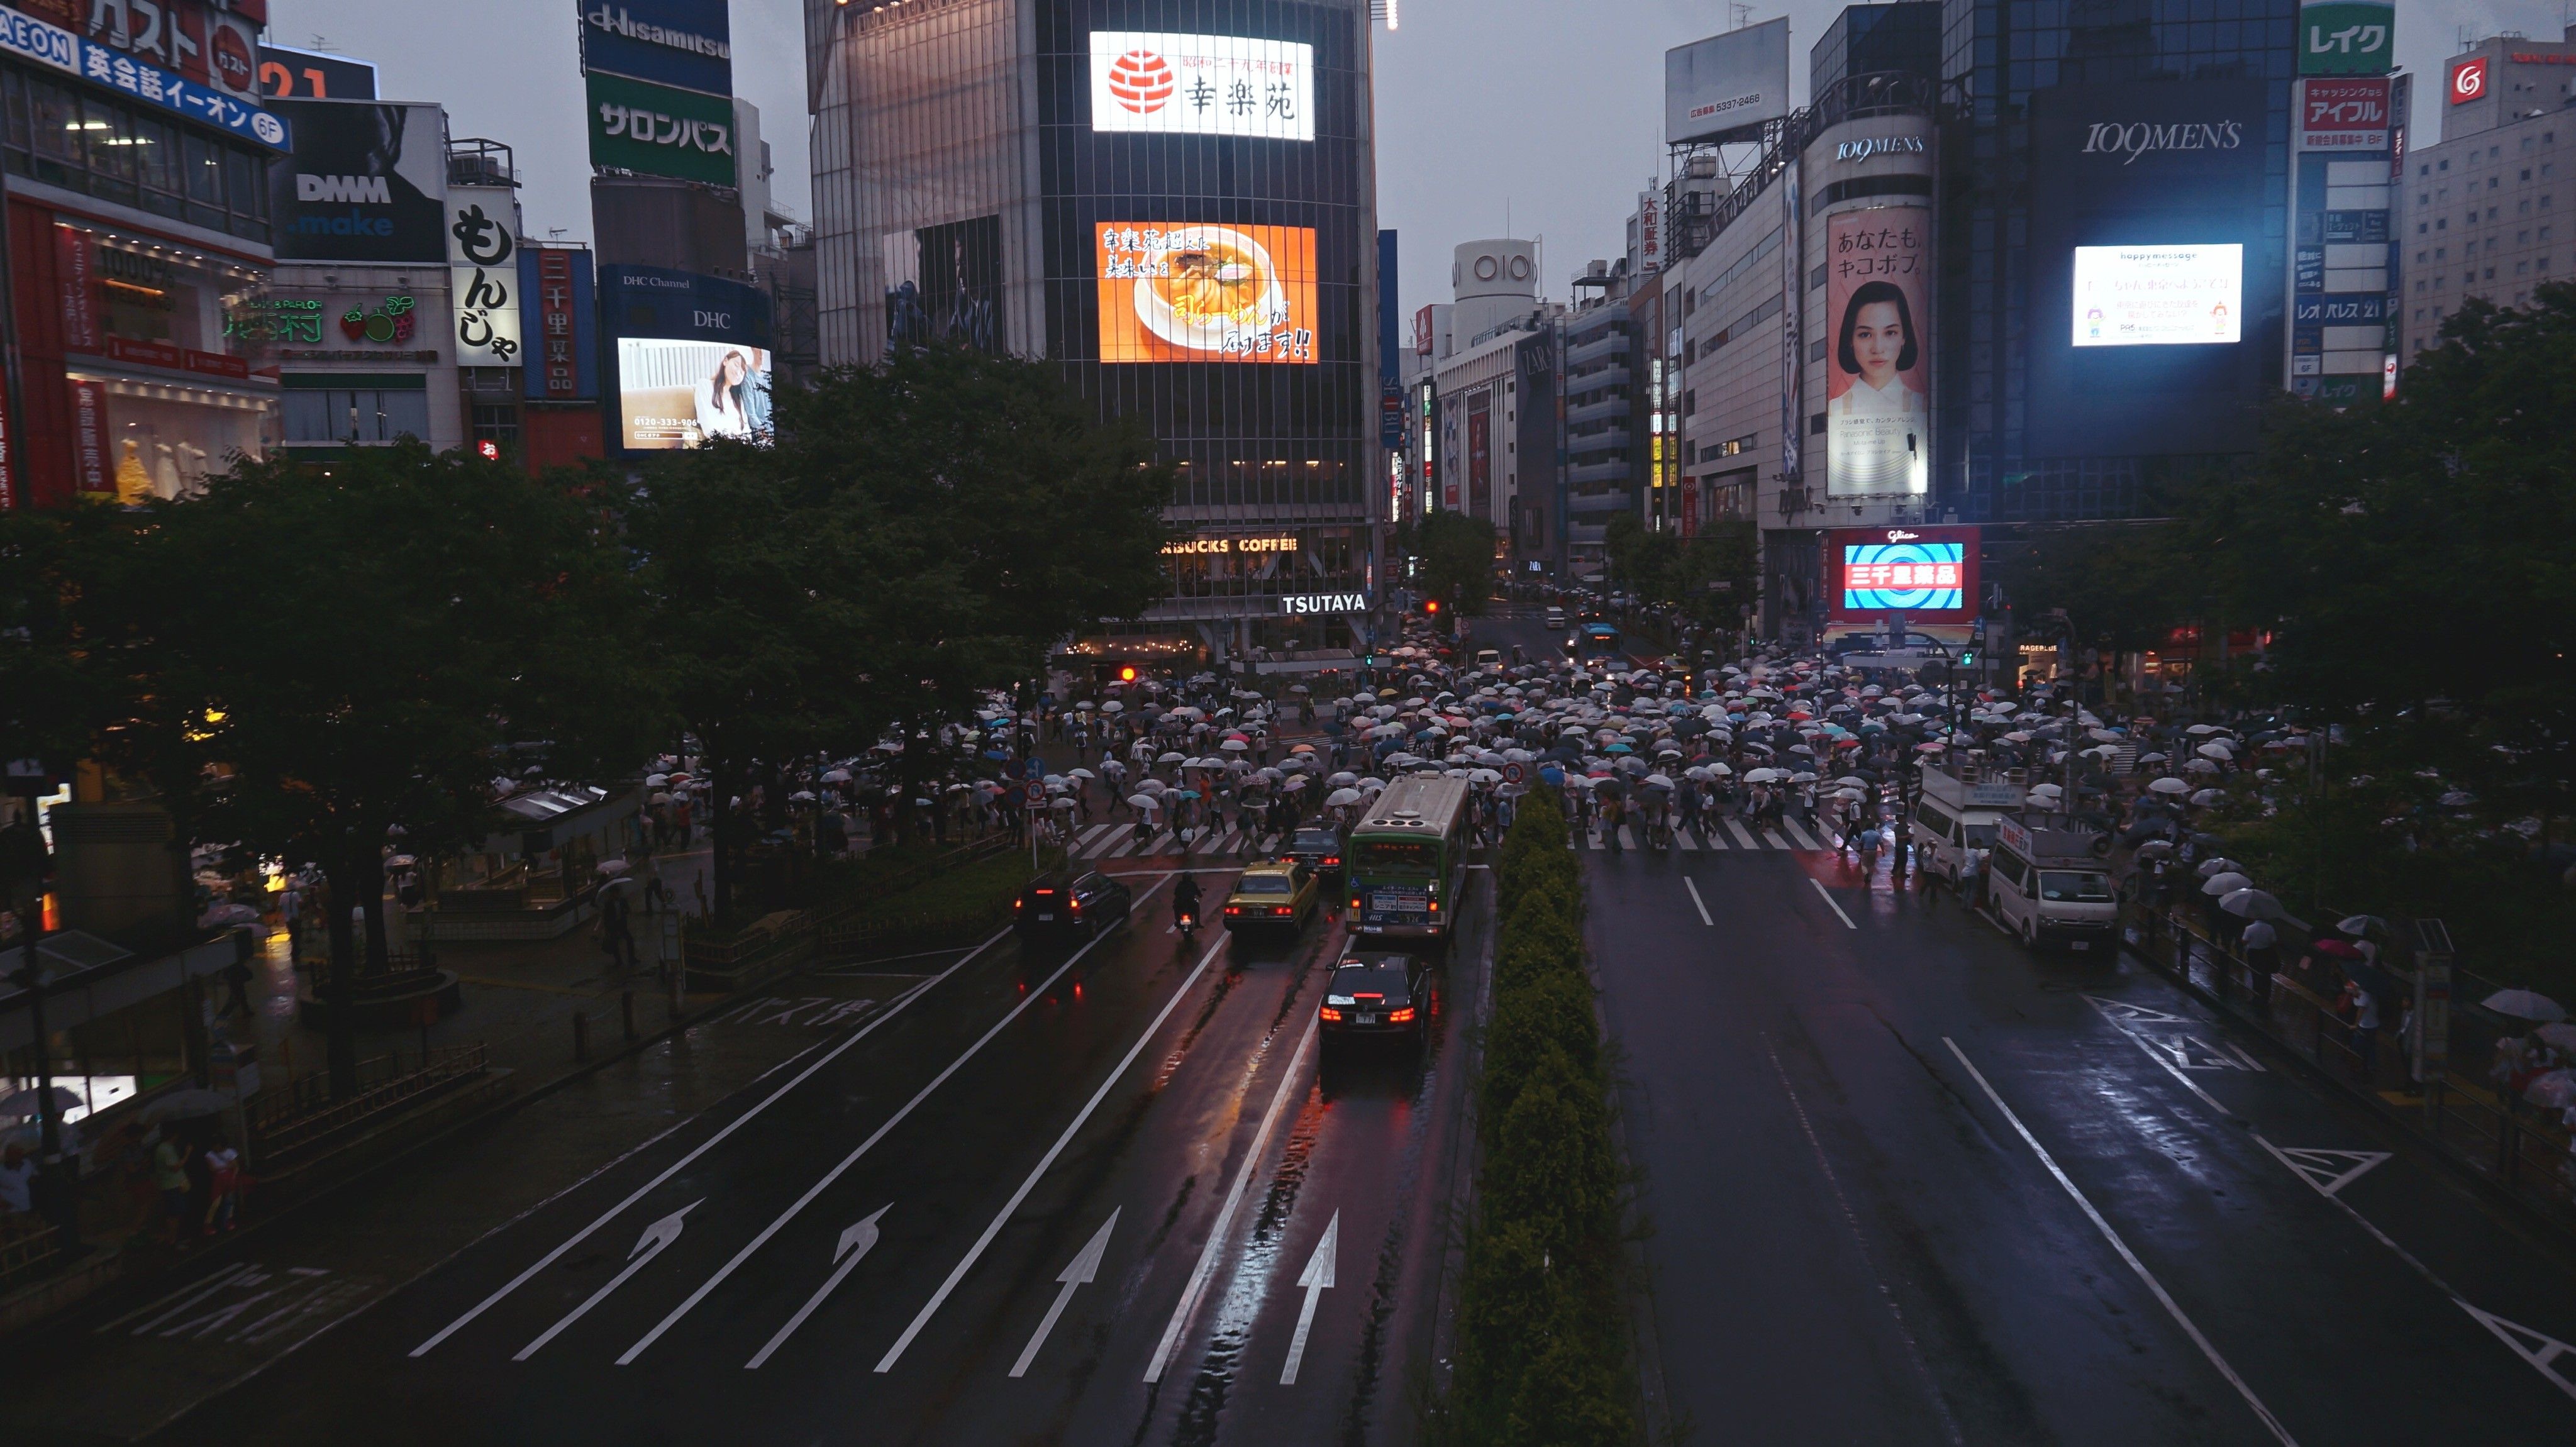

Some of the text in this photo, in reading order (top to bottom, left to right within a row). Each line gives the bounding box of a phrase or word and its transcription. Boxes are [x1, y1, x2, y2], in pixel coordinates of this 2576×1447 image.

[0, 11, 70, 65] AEON
[587, 3, 730, 59] Hisamitsu
[2310, 25, 2385, 53] レイク
[1182, 55, 1294, 75] 昭和二十九年創業
[85, 44, 247, 126] 英会話イーオン
[1185, 74, 1295, 119] 幸楽苑
[1716, 94, 1760, 112] 5337-2468
[2310, 101, 2383, 123] アイフル
[599, 102, 731, 156] サロンパス
[296, 174, 391, 203] DMM
[1643, 197, 1658, 255] 大和証券
[1838, 228, 1921, 253] あなたも、
[452, 203, 518, 362] もんじゃ
[624, 275, 689, 289] DHC Channel
[693, 310, 730, 329] DHC
[1840, 428, 1902, 438] Panasonic Beauty
[1238, 538, 1297, 553] COFFEE
[1888, 530, 1919, 543] Glico
[1851, 565, 1957, 586] 三千里薬品
[1283, 594, 1366, 614] TSUTAYA
